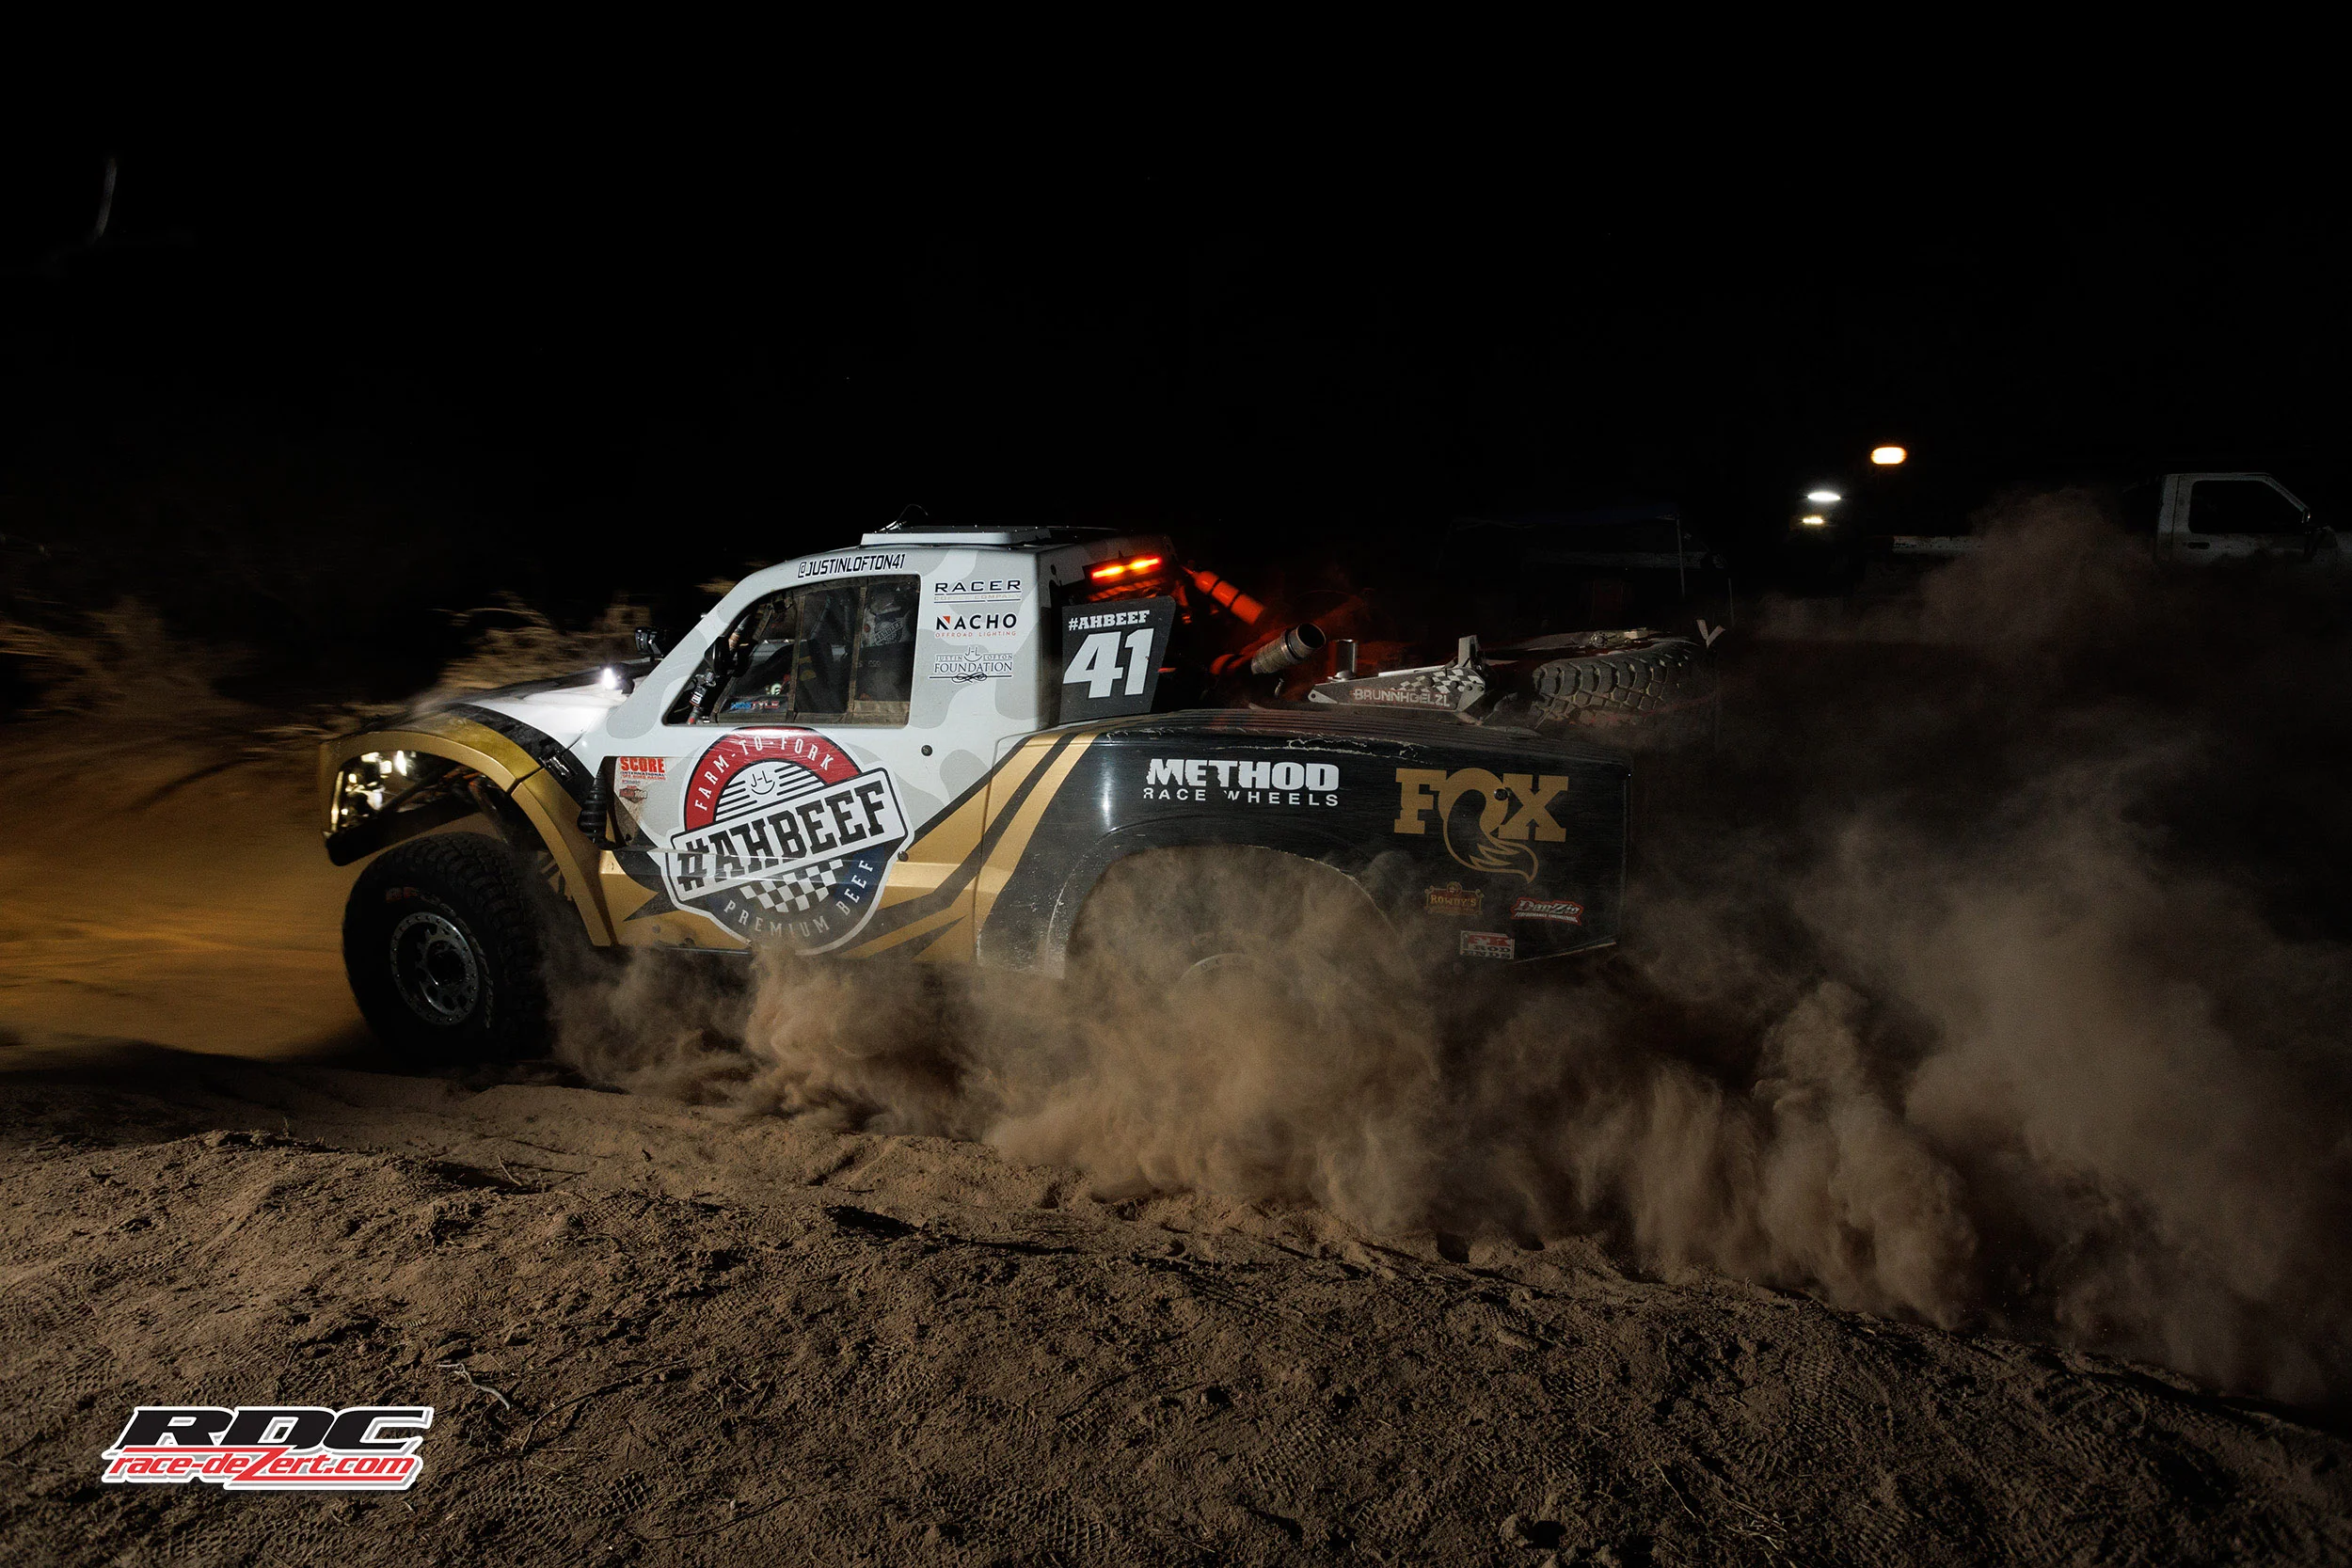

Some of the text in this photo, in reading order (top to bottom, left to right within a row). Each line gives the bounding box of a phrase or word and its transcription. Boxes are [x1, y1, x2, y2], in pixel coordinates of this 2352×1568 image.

[798, 553, 906, 578] @JUSTINLOFTON41
[934, 579, 1021, 593] RACER
[936, 613, 1017, 630] NACHO
[1068, 610, 1150, 631] #AHBEEF
[934, 661, 1013, 673] FOUNDATION
[1062, 627, 1154, 699] 41
[620, 756, 665, 773] SCORE
[1146, 758, 1340, 792] METHOD
[1143, 787, 1339, 807] RACE WHEELS
[1393, 768, 1569, 883] FOX
[676, 781, 885, 893] #AHBEEF
[723, 860, 874, 938] PREMIUM BEEF
[1473, 944, 1511, 953] ROD
